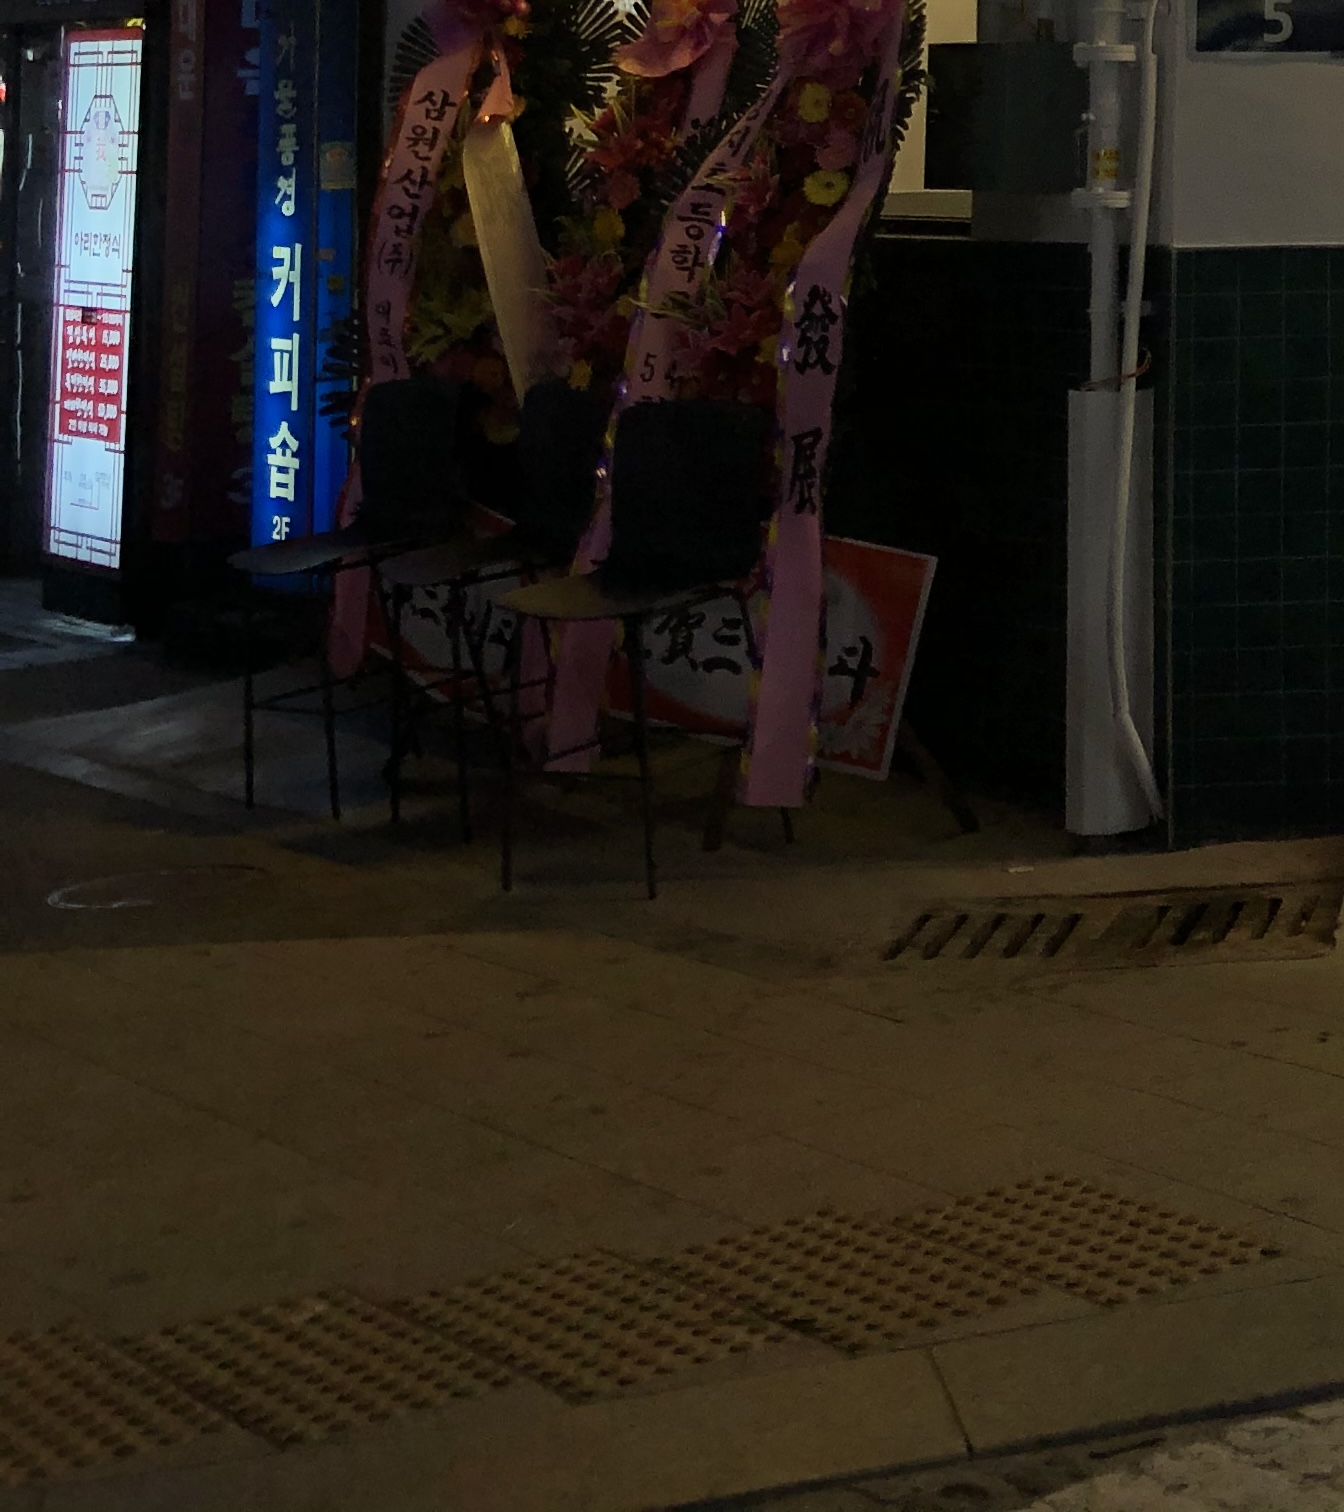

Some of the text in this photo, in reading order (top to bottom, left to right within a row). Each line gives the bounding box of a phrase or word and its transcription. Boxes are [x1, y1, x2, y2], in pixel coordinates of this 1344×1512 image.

[377, 88, 457, 278] 삼원산업(주)
[74, 230, 122, 260] 아리한정식
[267, 241, 303, 504] 커피숍
[272, 512, 291, 542] 2F
